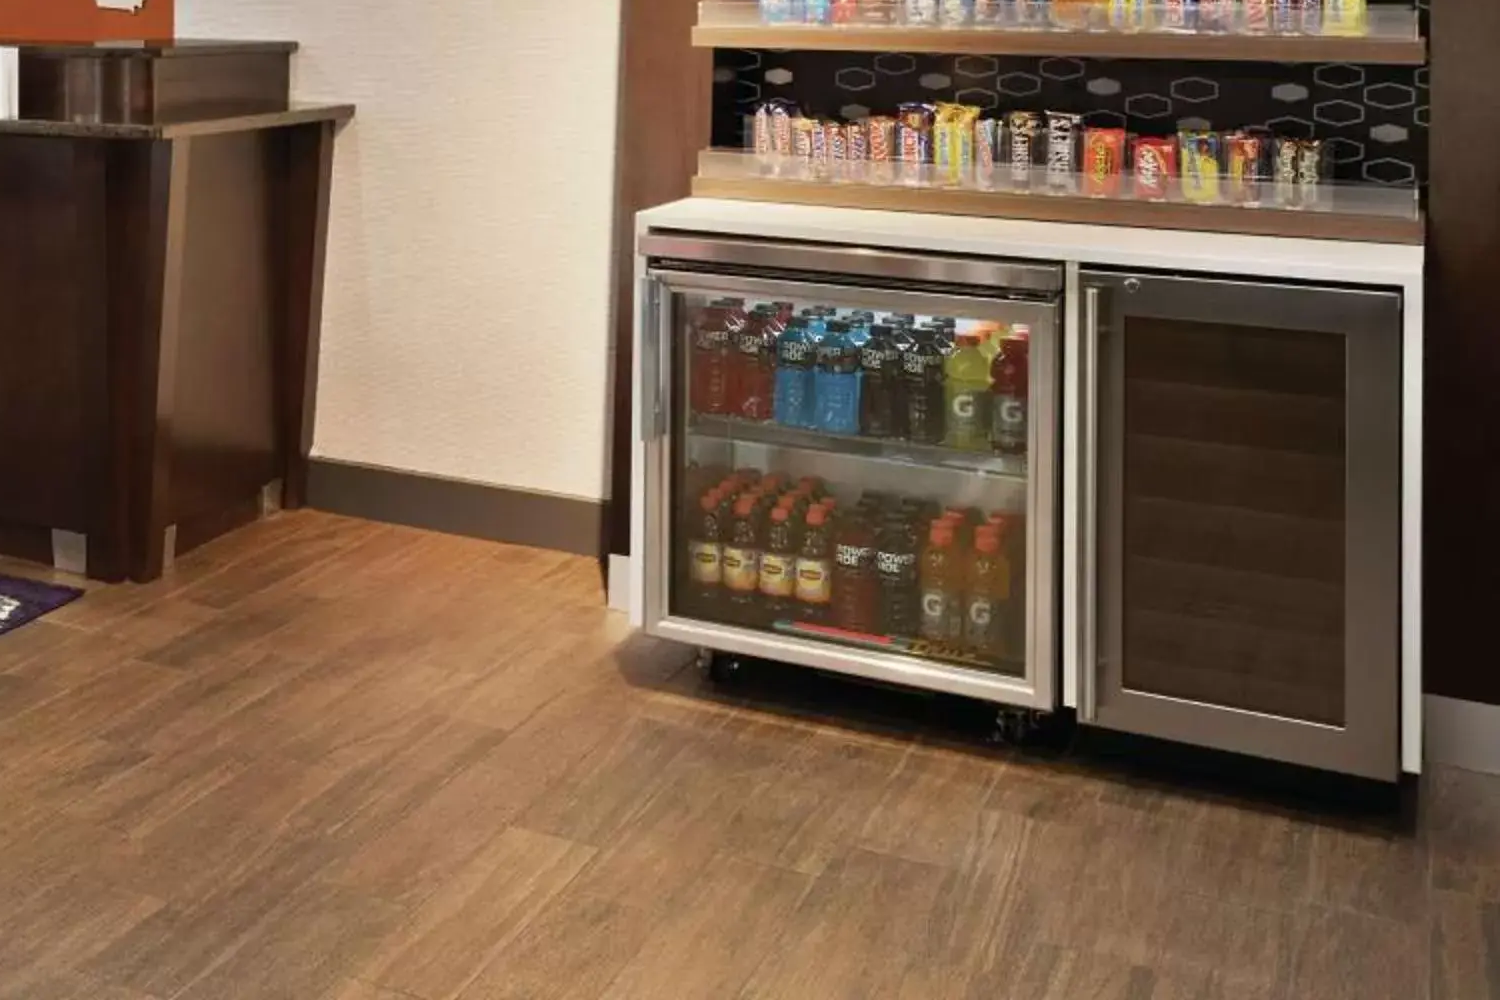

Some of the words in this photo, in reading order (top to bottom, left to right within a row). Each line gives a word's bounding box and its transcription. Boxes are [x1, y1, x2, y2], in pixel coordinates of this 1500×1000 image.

[952, 394, 975, 418] G
[1001, 401, 1024, 423] G
[922, 593, 943, 617] G
[968, 602, 991, 625] G
